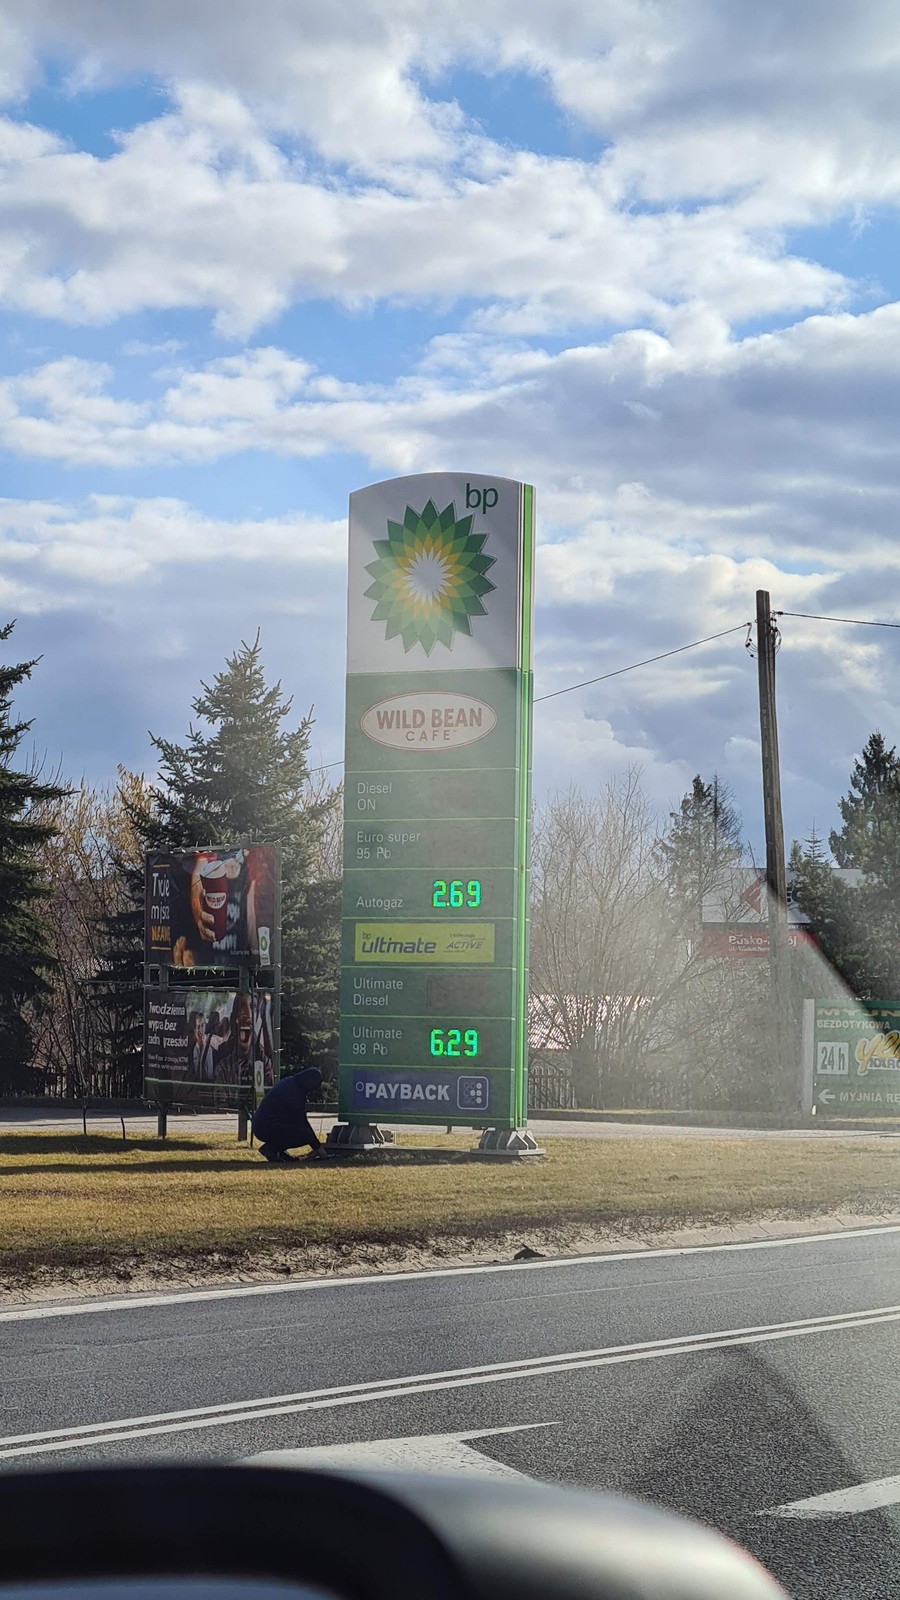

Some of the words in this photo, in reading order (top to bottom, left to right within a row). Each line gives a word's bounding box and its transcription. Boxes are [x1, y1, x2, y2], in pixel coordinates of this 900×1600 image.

[465, 482, 499, 515] bp
[376, 709, 426, 730] WILD
[431, 707, 483, 728] BEAN
[405, 729, 451, 742] CAFE
[357, 782, 392, 794] Diesel
[357, 798, 376, 811] ON
[356, 831, 384, 843] Euro
[388, 831, 421, 845] super
[356, 848, 370, 859] 95
[376, 846, 392, 859] Pb
[432, 879, 482, 908] 2.69
[355, 896, 404, 911] Autogaz
[362, 931, 372, 940] bp
[361, 937, 437, 954] ultimate
[445, 941, 484, 950] ACTIVE
[353, 977, 404, 990] Ultimate
[353, 994, 389, 1006] Diesel
[816, 1019, 891, 1030] BEZDOTYKOWA
[352, 1026, 403, 1040] Ultimate
[352, 1043, 367, 1056] 98
[373, 1042, 388, 1056] Pb
[429, 1028, 480, 1057] 6.29
[820, 1046, 835, 1071] 24
[838, 1047, 846, 1071] h
[365, 1082, 451, 1101] PAYBACK
[839, 1092, 883, 1103] MYJNIA
